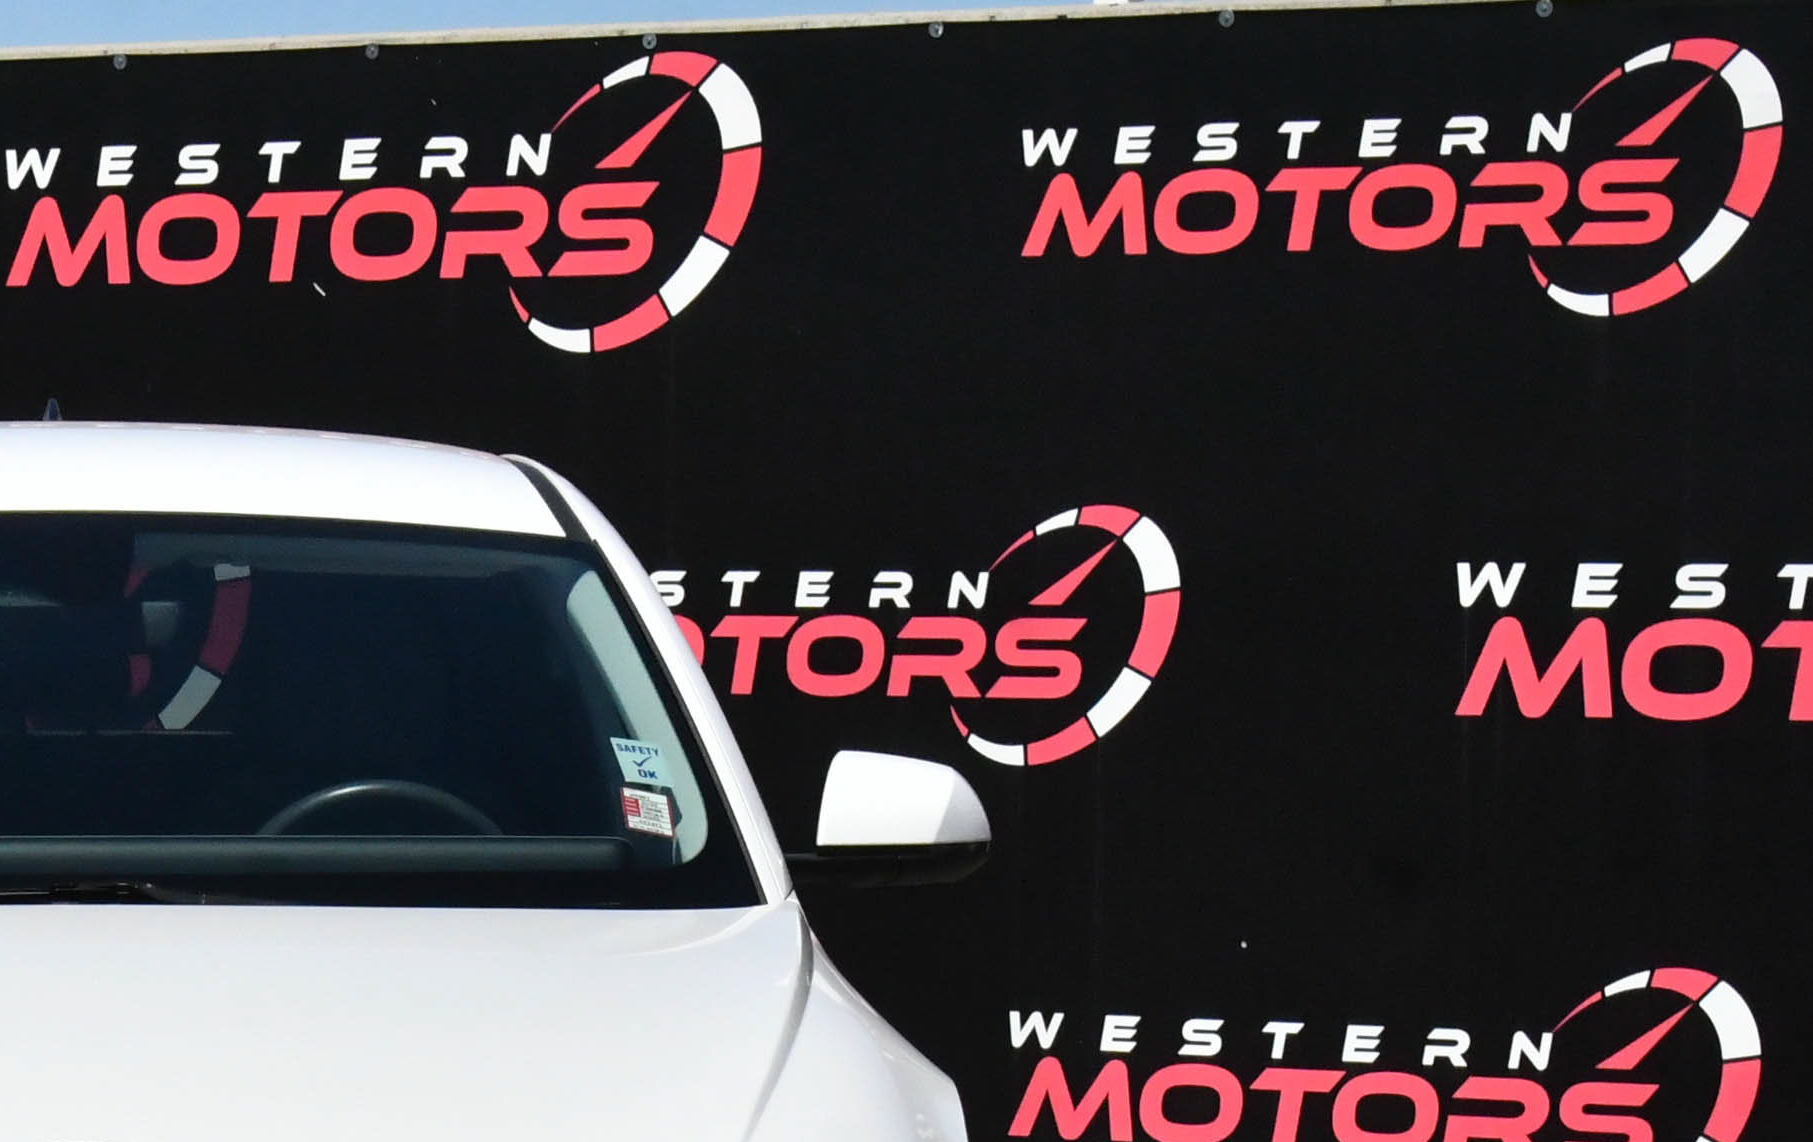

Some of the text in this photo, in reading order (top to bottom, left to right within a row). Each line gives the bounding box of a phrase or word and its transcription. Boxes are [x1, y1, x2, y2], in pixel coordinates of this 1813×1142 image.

[6, 133, 551, 190] WESTERN
[1022, 113, 1572, 167] WESTERN
[5, 181, 660, 287] MOTORS
[1021, 158, 1680, 258] MOTORS
[673, 614, 1088, 699] TORS
[616, 743, 659, 756] SAFETY
[637, 769, 658, 780] OK
[1009, 1011, 1553, 1071] WESTERN
